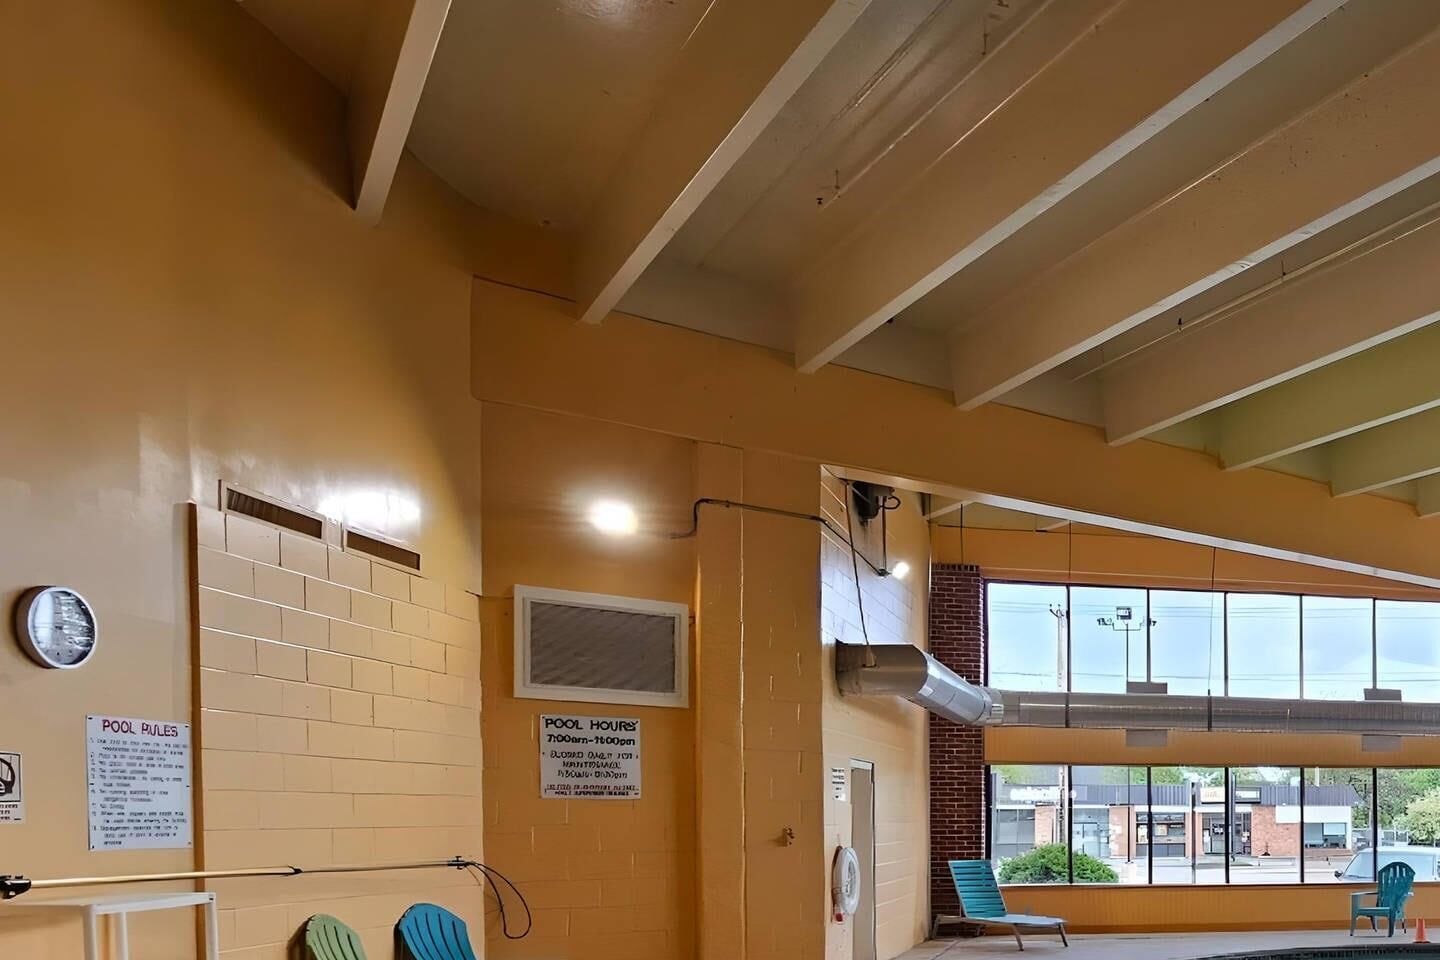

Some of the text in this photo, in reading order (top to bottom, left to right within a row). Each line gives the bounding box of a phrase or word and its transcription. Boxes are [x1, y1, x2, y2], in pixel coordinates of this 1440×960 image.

[102, 719, 178, 737] POOL RULES
[544, 718, 637, 732] POOL HOURS
